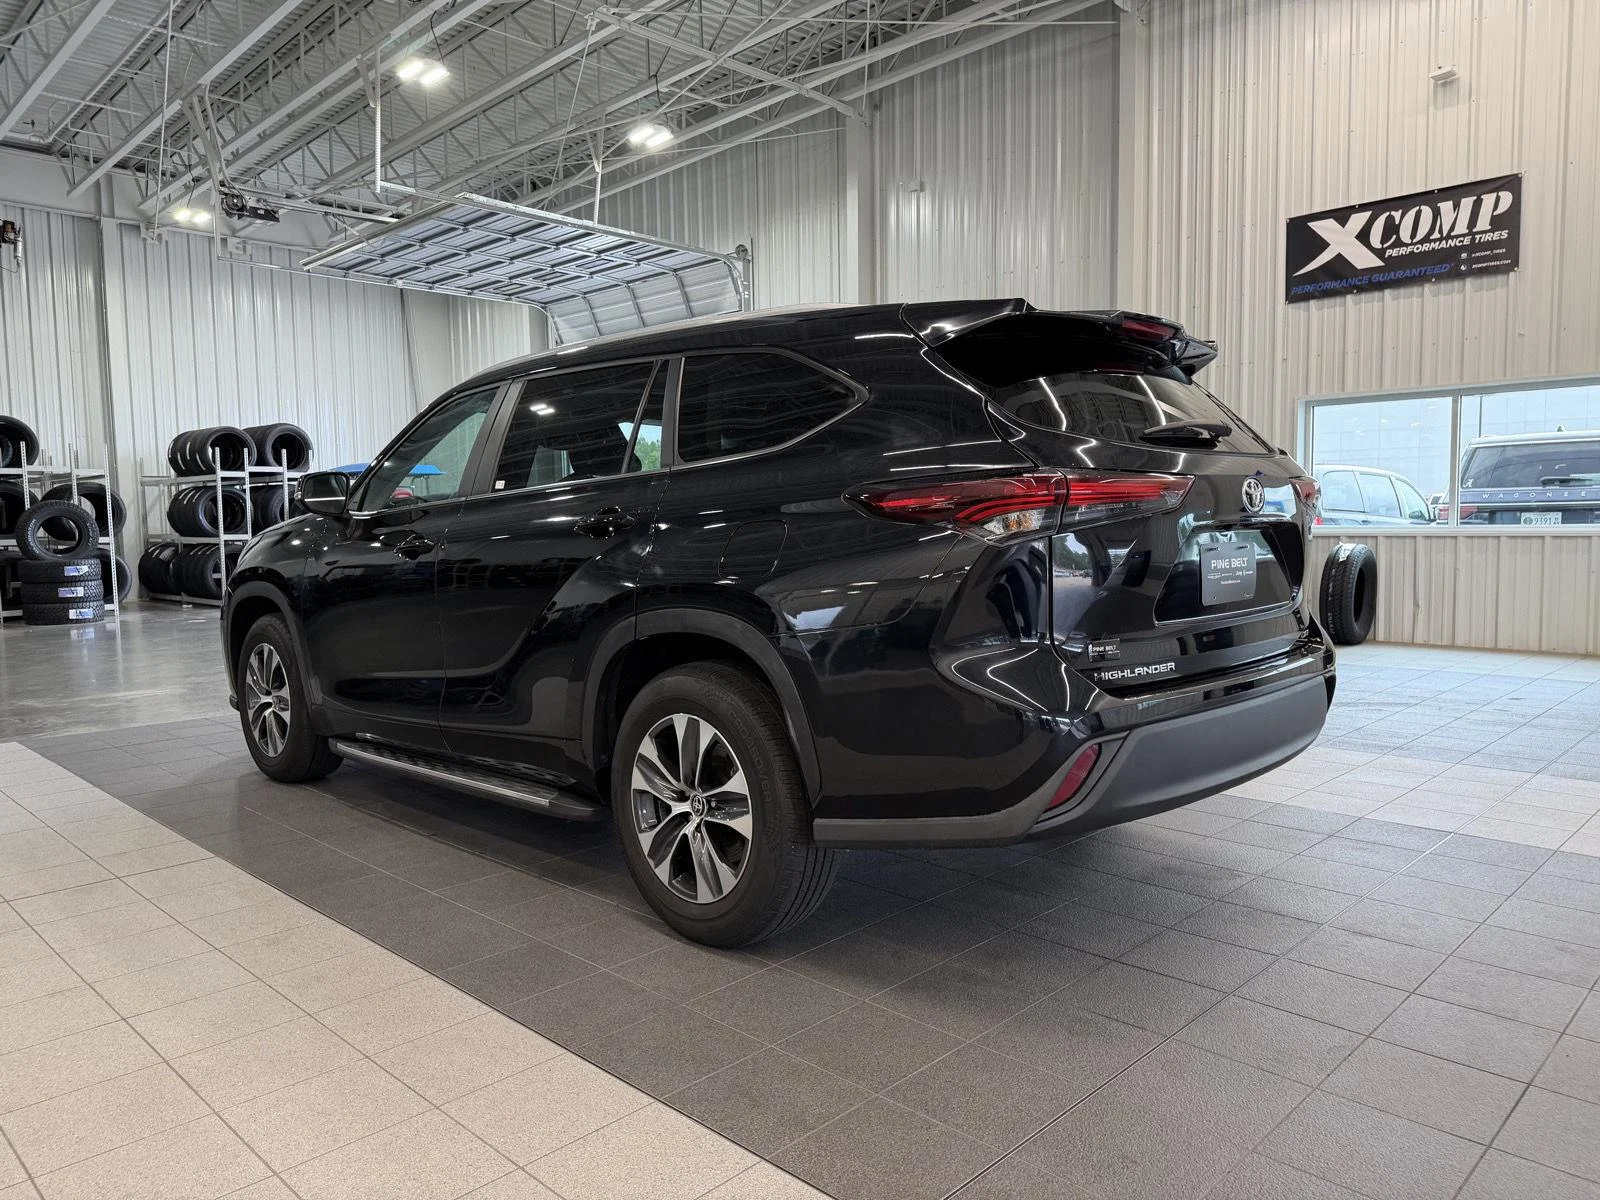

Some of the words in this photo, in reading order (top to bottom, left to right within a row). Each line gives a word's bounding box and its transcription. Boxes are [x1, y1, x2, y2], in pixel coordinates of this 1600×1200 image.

[1384, 236, 1471, 258] PERFORMANCE
[1475, 229, 1509, 244] TIRES
[1291, 275, 1369, 296] PERFORMANCE
[1371, 263, 1451, 283] GUARANTEED
[1211, 558, 1229, 570] PINE
[1231, 557, 1248, 568] BELT
[1094, 662, 1176, 681] HIGHLANDER
